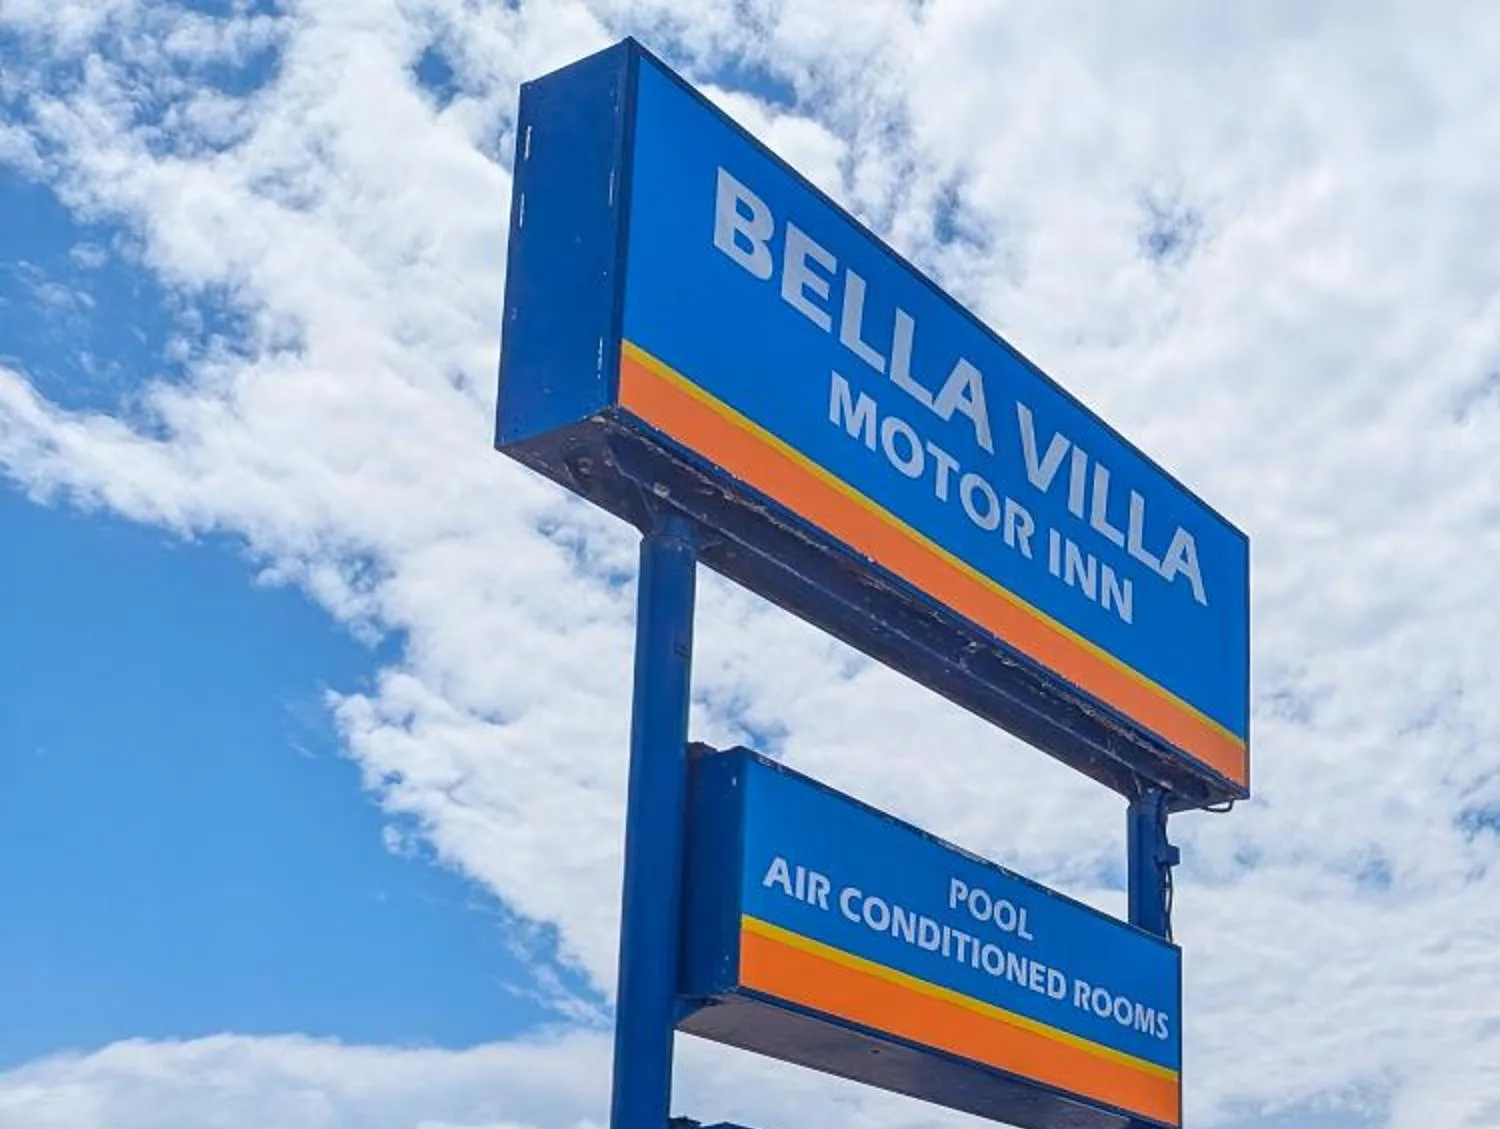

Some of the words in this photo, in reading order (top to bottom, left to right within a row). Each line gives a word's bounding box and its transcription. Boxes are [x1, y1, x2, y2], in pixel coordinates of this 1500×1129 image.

[713, 166, 995, 455] BELLA
[1016, 401, 1208, 606] VILLA
[829, 371, 1035, 559] MOTOR
[1048, 527, 1133, 624] INN
[763, 857, 831, 910] AIR
[839, 886, 1067, 999] CONDITIONED
[1073, 979, 1169, 1039] ROOMS
[949, 878, 1033, 940] POOL
